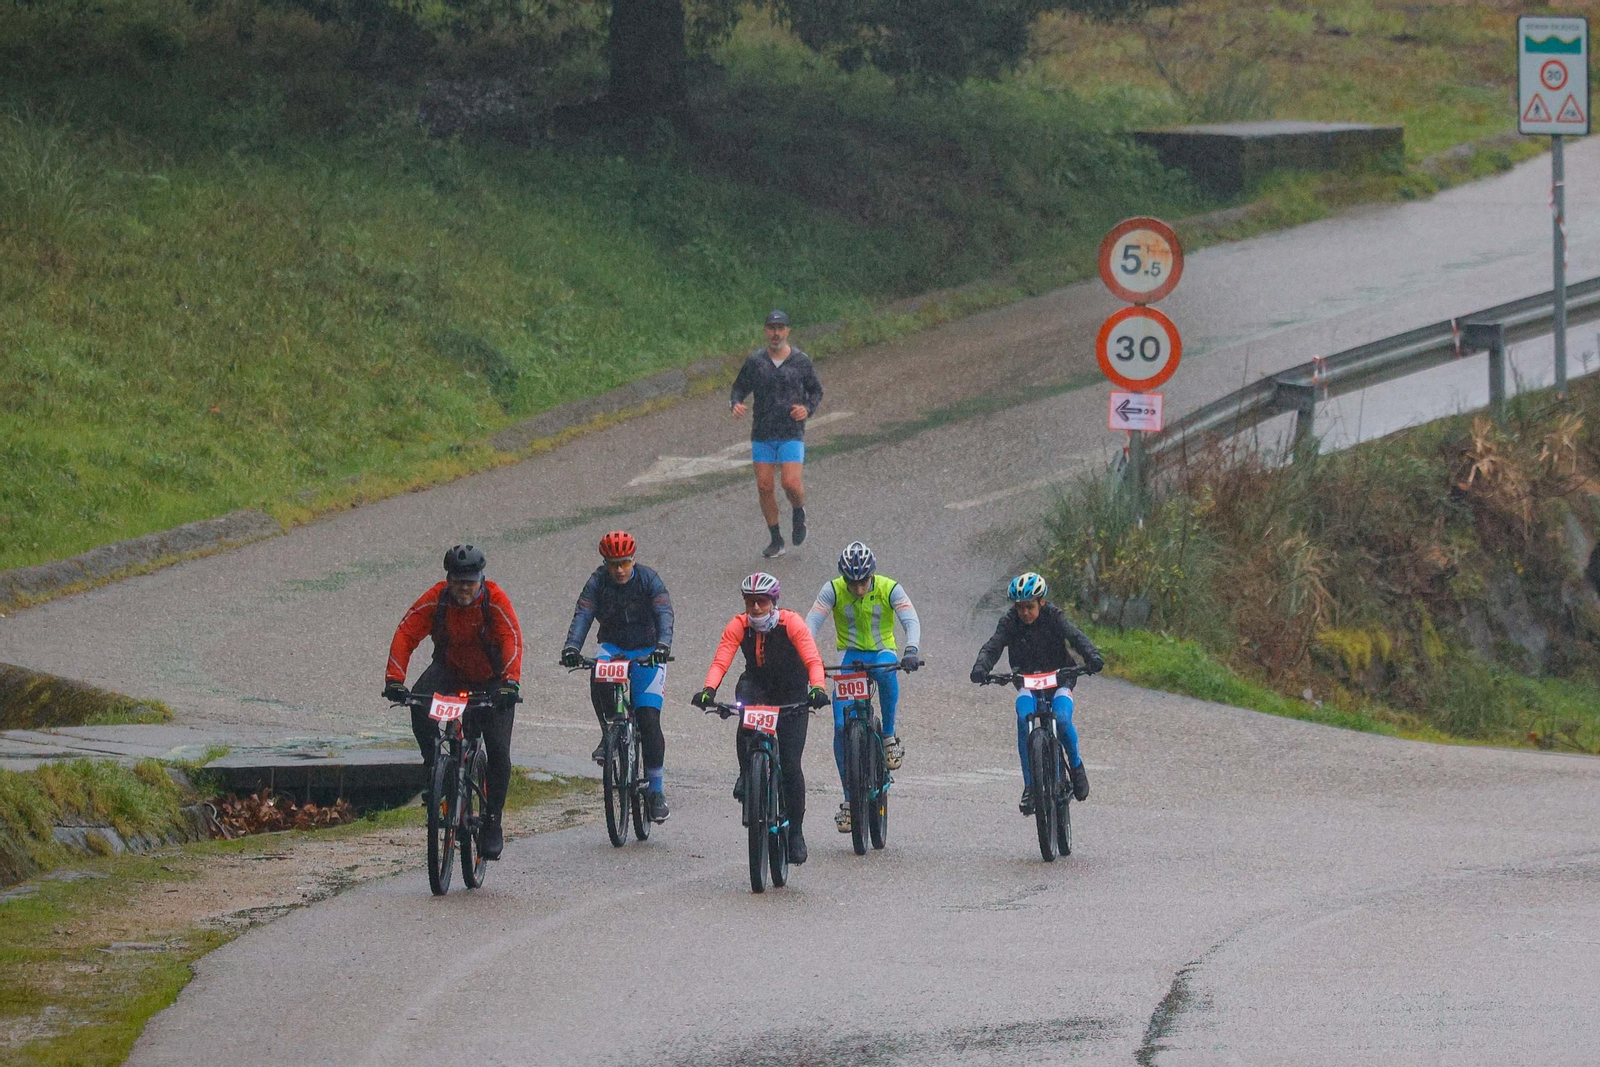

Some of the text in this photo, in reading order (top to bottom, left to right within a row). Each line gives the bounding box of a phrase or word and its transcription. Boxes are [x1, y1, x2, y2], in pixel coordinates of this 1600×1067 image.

[1546, 70, 1562, 81] 30
[1115, 335, 1160, 363] 30
[598, 664, 625, 677] 608
[838, 681, 864, 696] 609
[1033, 678, 1048, 687] 21
[435, 704, 460, 717] 641
[747, 712, 775, 728] 639
